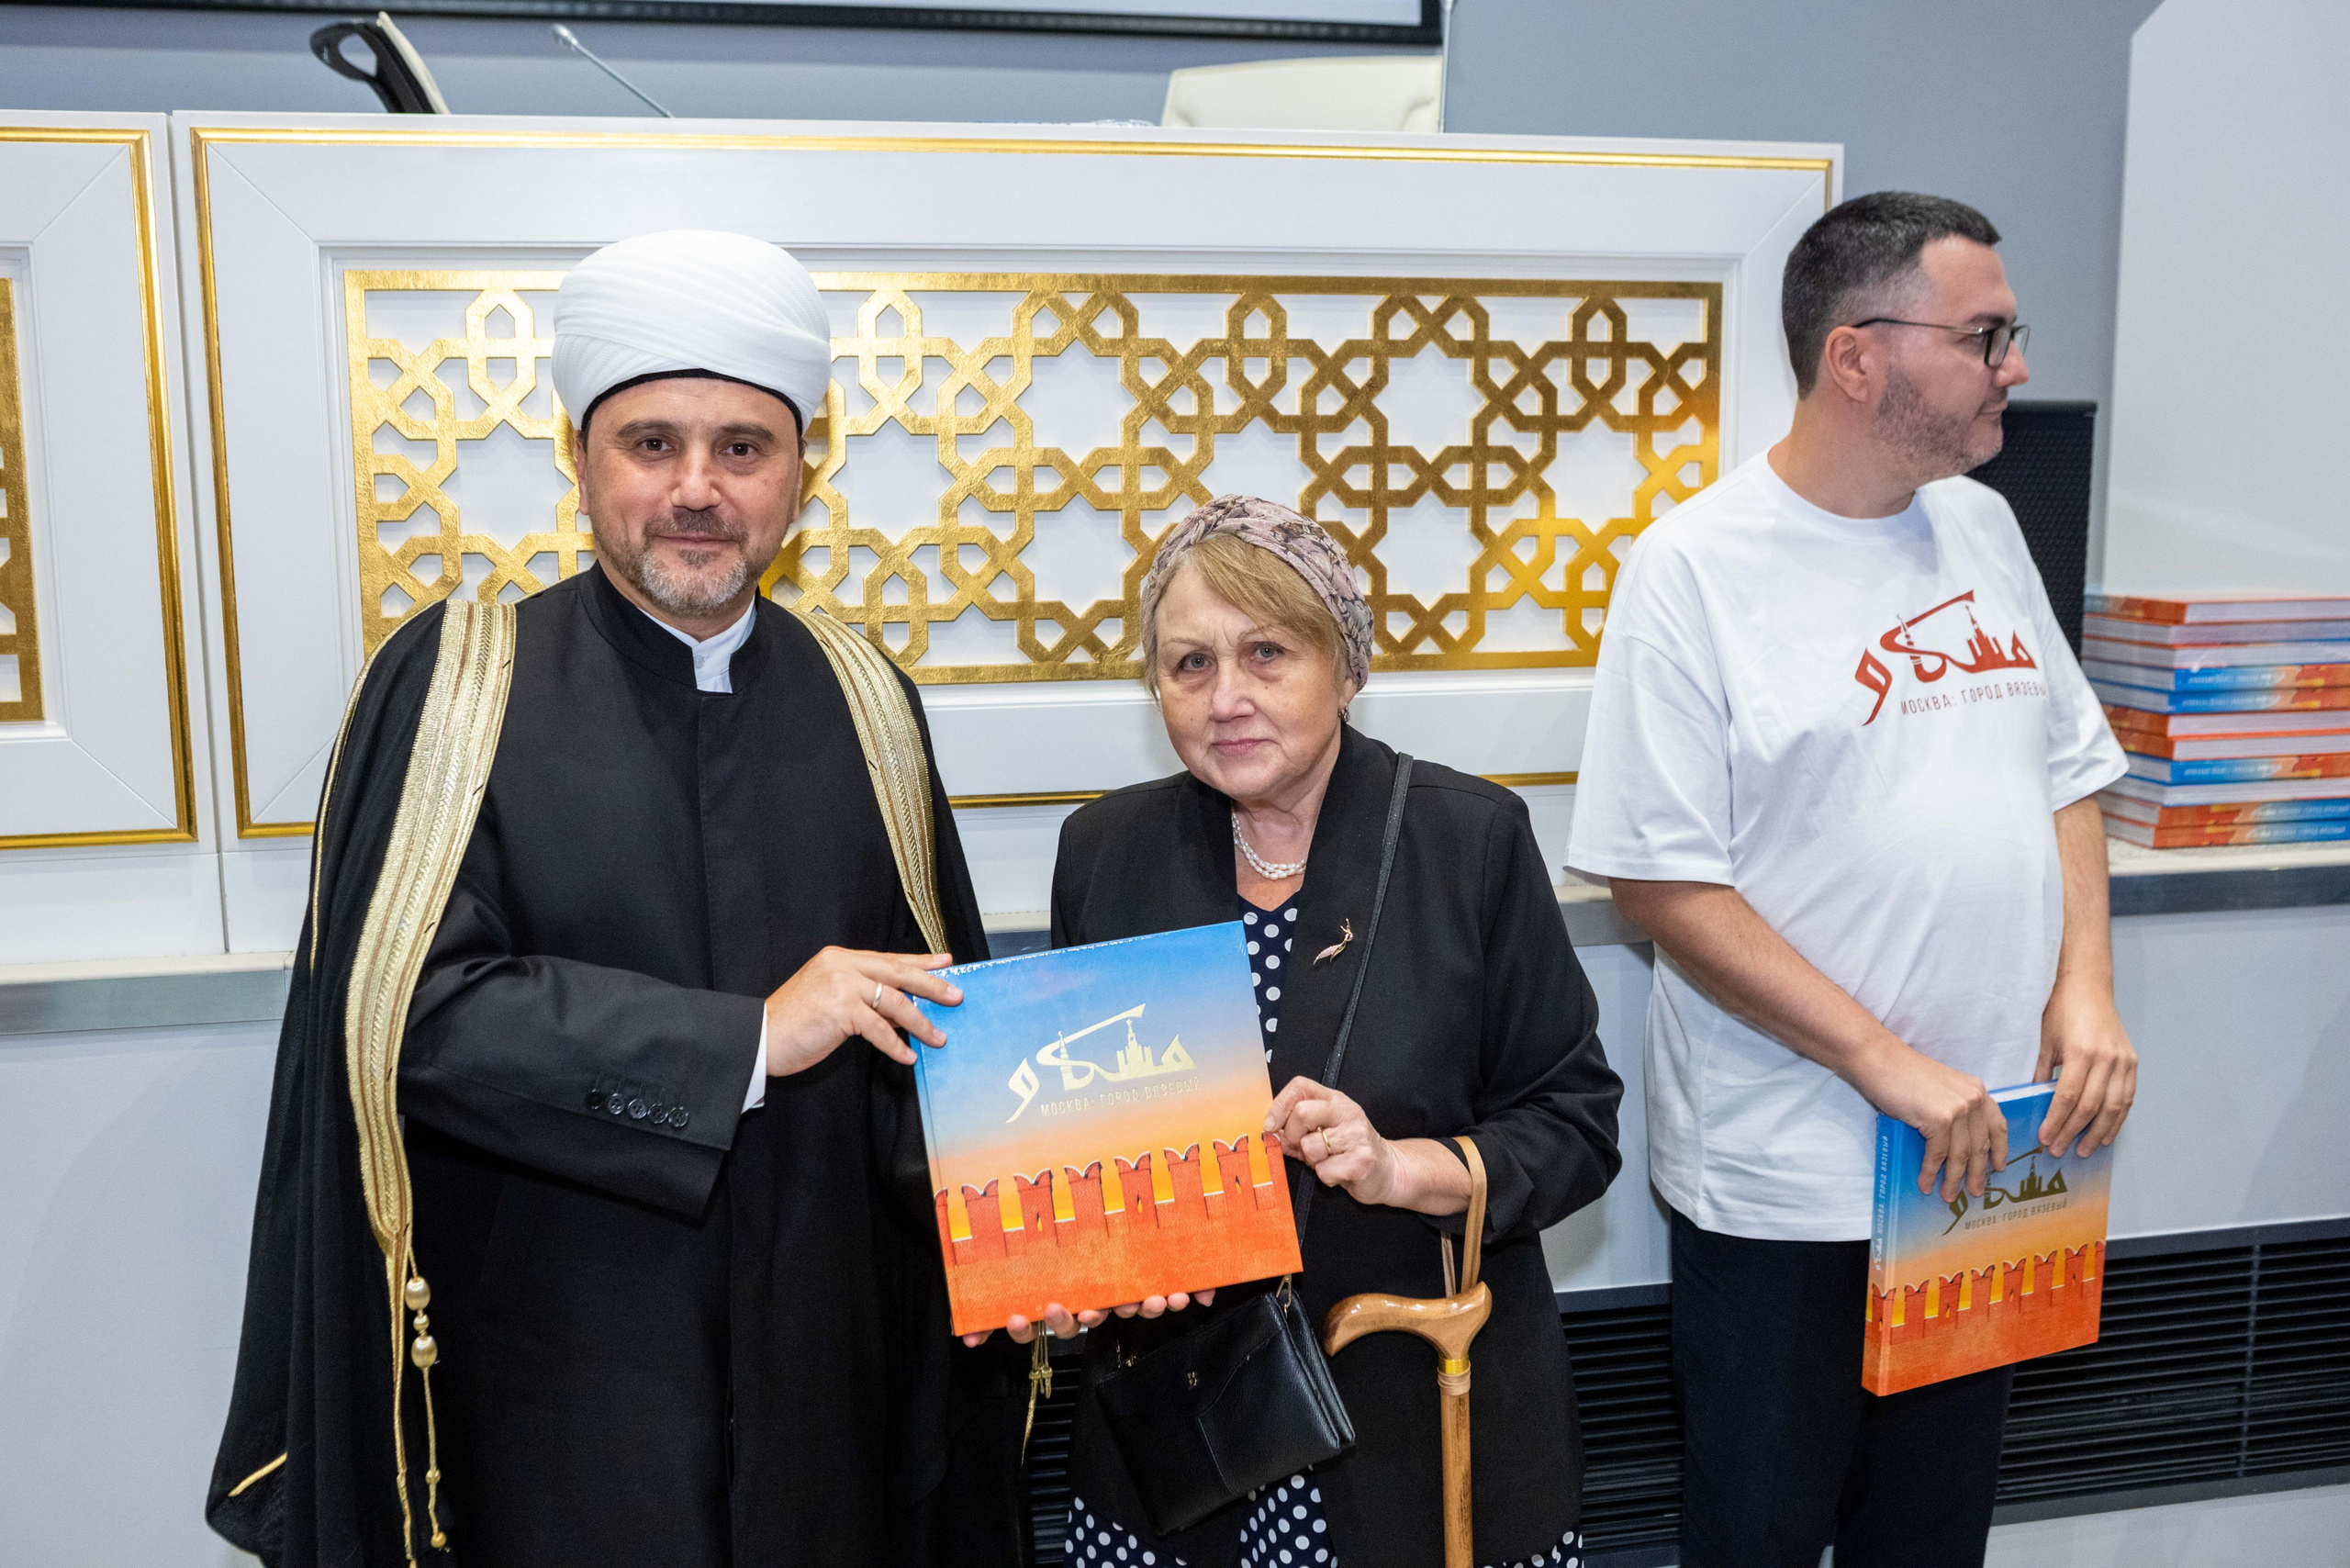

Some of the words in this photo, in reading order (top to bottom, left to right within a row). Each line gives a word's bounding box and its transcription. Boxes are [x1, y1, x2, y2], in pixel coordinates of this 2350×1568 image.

[1900, 694, 1957, 716] МОСКВА:
[1961, 683, 2004, 704] ГОРОД
[1040, 1097, 1095, 1117] МОСКВА:
[1100, 1088, 1139, 1106] ГОРОД
[1144, 1076, 1202, 1099] ВЯЗЕВЫЙ
[1880, 1136, 1889, 1172] ВЯЗЕВЫЙ
[1879, 1174, 1887, 1200] ГОРОД
[2002, 1207, 2029, 1222] ГОРОД
[2031, 1198, 2068, 1216] ВЯЗЕВЫЙ
